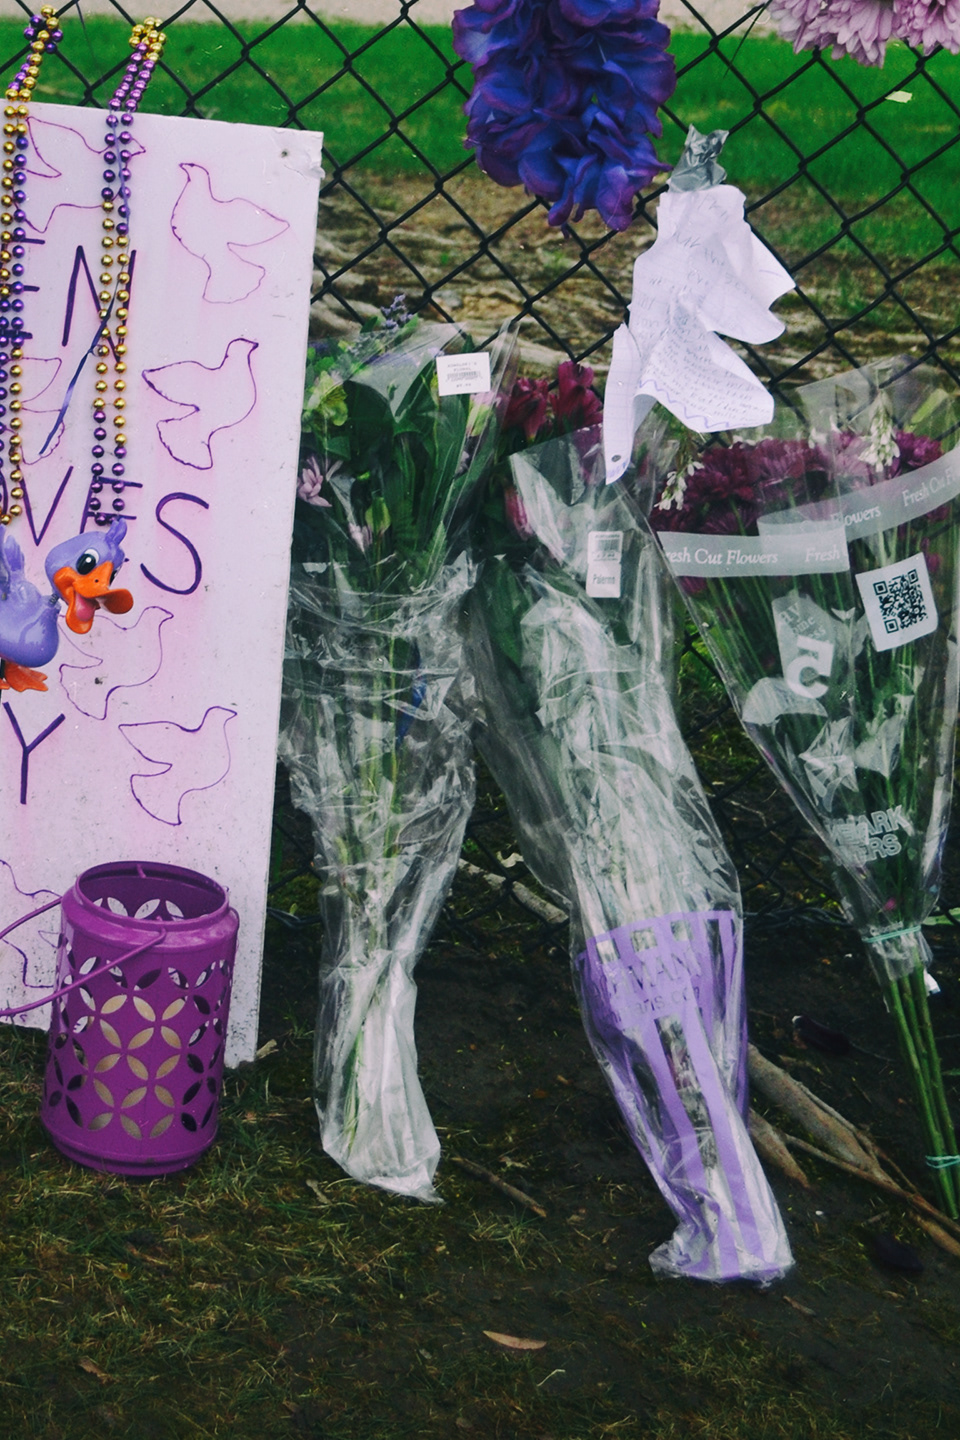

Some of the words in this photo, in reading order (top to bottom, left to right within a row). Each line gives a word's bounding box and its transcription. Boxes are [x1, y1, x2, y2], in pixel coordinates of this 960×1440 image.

[694, 548, 723, 566] Cut
[725, 550, 779, 566] Flowers
[805, 545, 841, 562] Fresh
